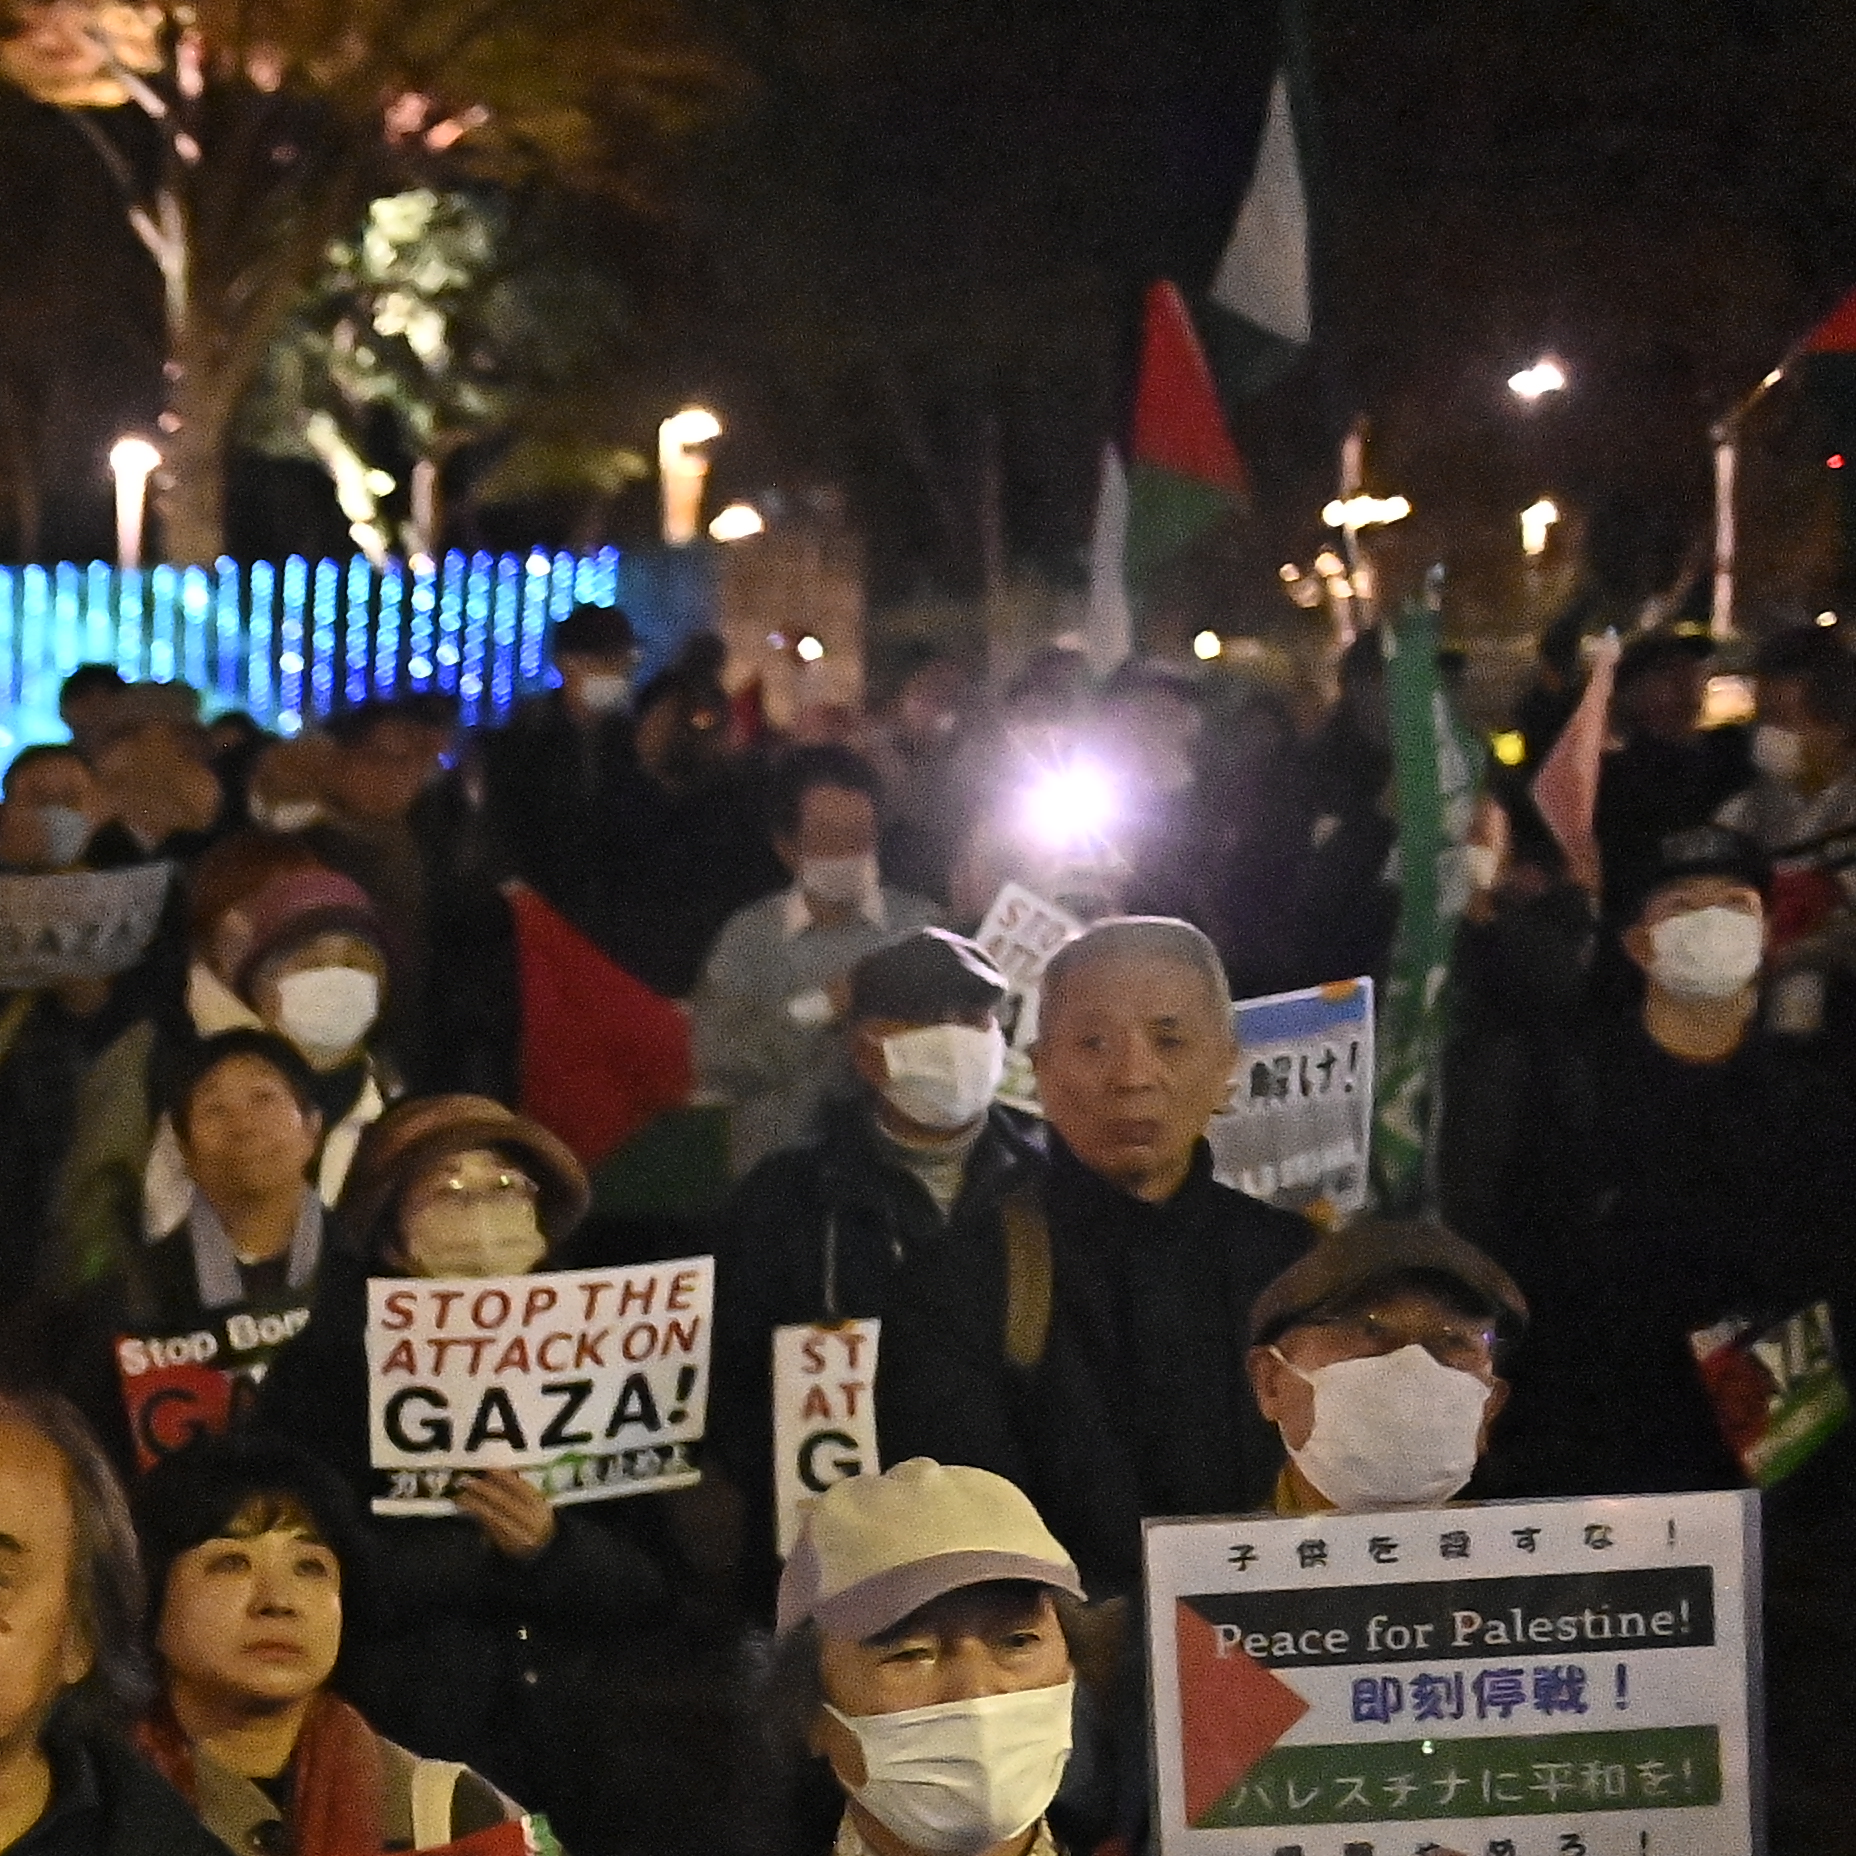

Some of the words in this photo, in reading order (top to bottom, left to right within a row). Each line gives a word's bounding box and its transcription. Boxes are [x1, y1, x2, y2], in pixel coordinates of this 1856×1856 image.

[381, 1284, 558, 1330] STOP
[578, 1268, 701, 1323] THE
[118, 1329, 219, 1377] Stop
[381, 1326, 611, 1379] ATTACK
[621, 1314, 701, 1364] ON
[383, 1362, 699, 1454] GAZA!
[1214, 1621, 1350, 1662] Peace
[1365, 1613, 1437, 1655] for
[1451, 1600, 1690, 1648] Palestine!
[1350, 1662, 1630, 1726] 即刻停戦！
